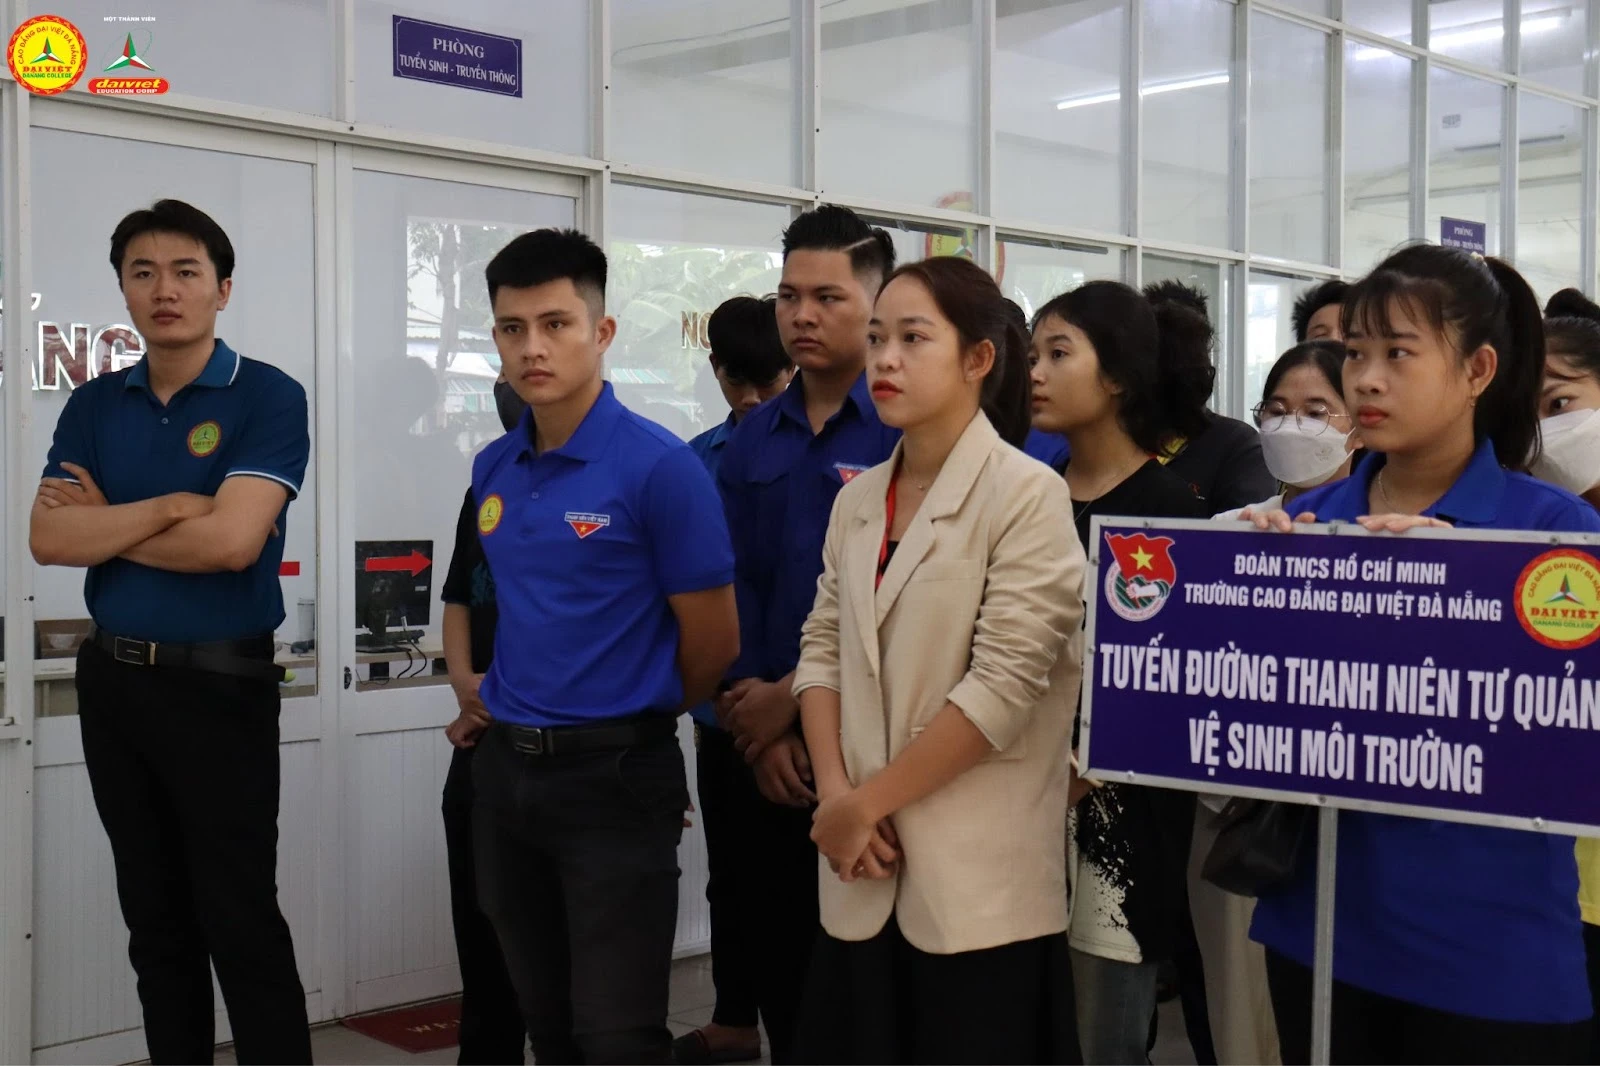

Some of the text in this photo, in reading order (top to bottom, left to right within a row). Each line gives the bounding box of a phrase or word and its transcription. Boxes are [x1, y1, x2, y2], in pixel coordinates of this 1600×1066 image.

[432, 37, 485, 59] PHÒNG
[399, 51, 427, 70] TUYỂN
[428, 59, 449, 74] SINH
[455, 63, 487, 81] TRUYỀN
[488, 69, 516, 86] THÔNG
[1234, 551, 1446, 585] ĐOÀN TNCS HỒ CHÍ MINH
[1184, 580, 1249, 607] TRƯỜNG
[1252, 586, 1286, 609] CAO
[1289, 580, 1338, 612] ĐẲNG
[1341, 591, 1372, 618] ĐẠI
[1376, 590, 1415, 620] VIỆT
[1417, 591, 1444, 619] ĐÀ
[1447, 590, 1502, 622] NẴNG
[1100, 633, 1600, 733] TUYẾN ĐƯỜNG THANH NIÊN TỰ QUẢN
[1188, 710, 1484, 795] VỆ SINH MÔI TRƯỜNG
